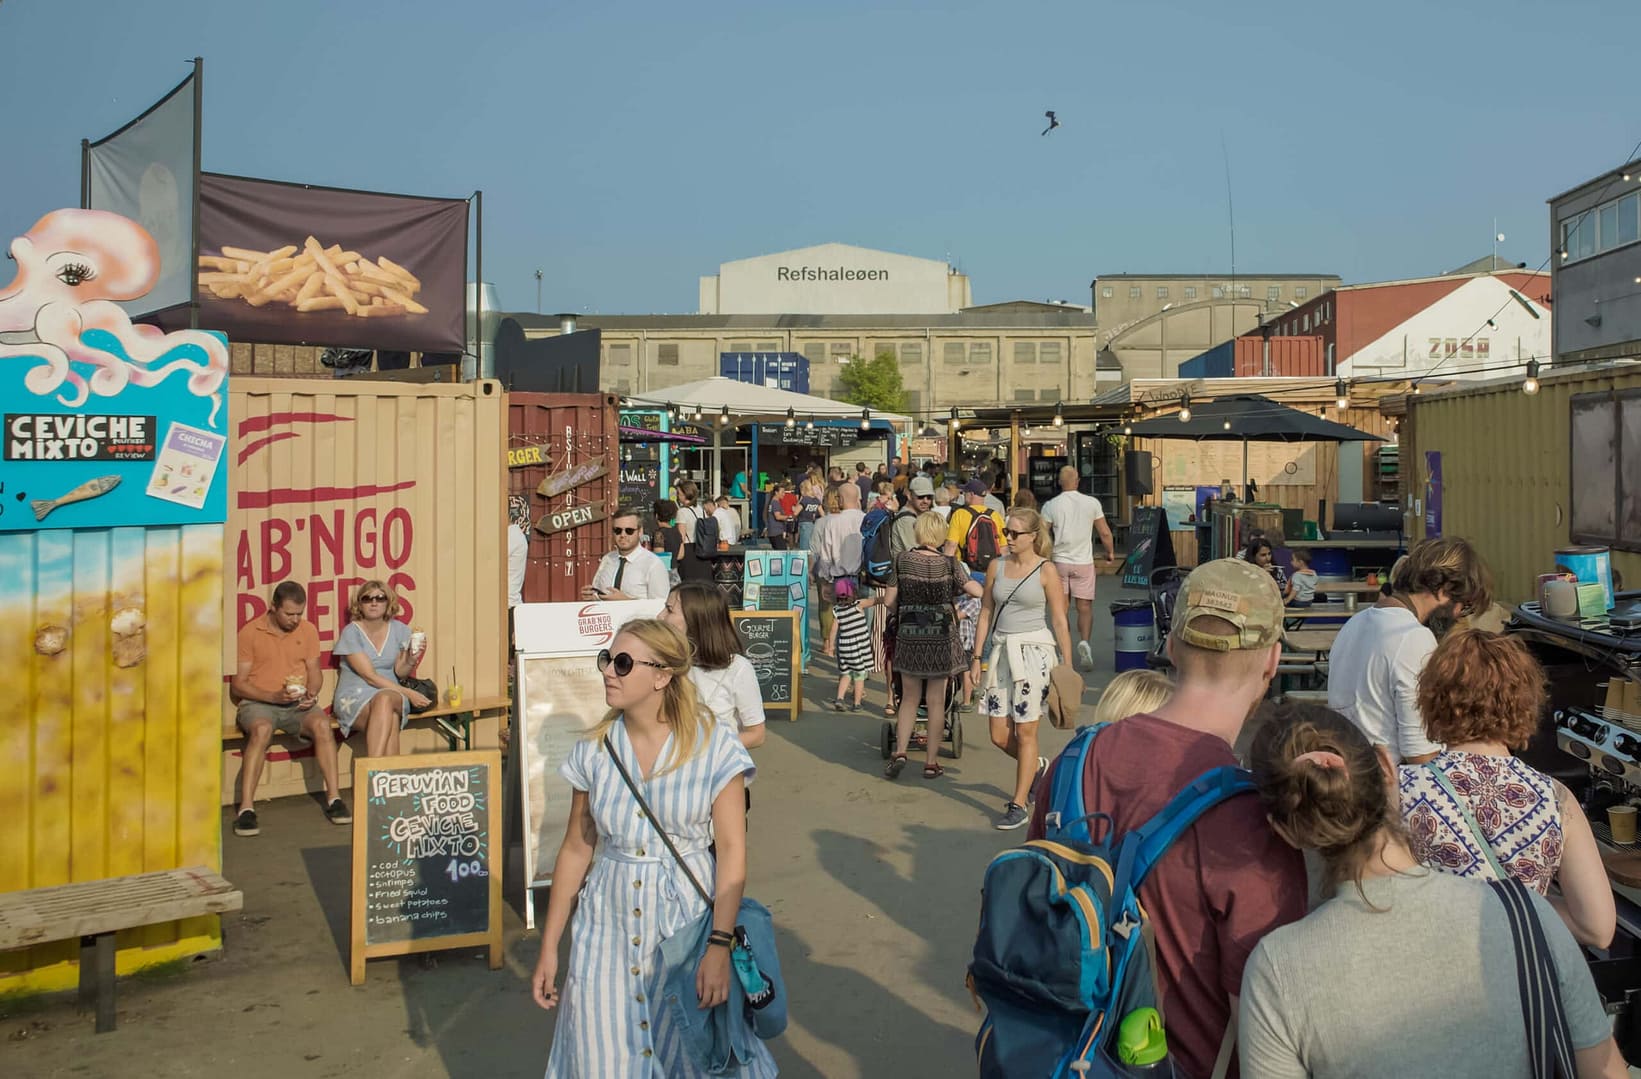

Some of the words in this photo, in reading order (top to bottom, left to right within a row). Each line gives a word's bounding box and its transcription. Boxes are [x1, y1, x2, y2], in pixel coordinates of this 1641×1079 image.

[777, 266, 889, 281] Refshaleøen
[552, 507, 593, 529] OPEN
[580, 623, 612, 634] BURGERS
[421, 793, 475, 815] FOOD
[379, 860, 399, 870] cod
[375, 912, 420, 925] banana
